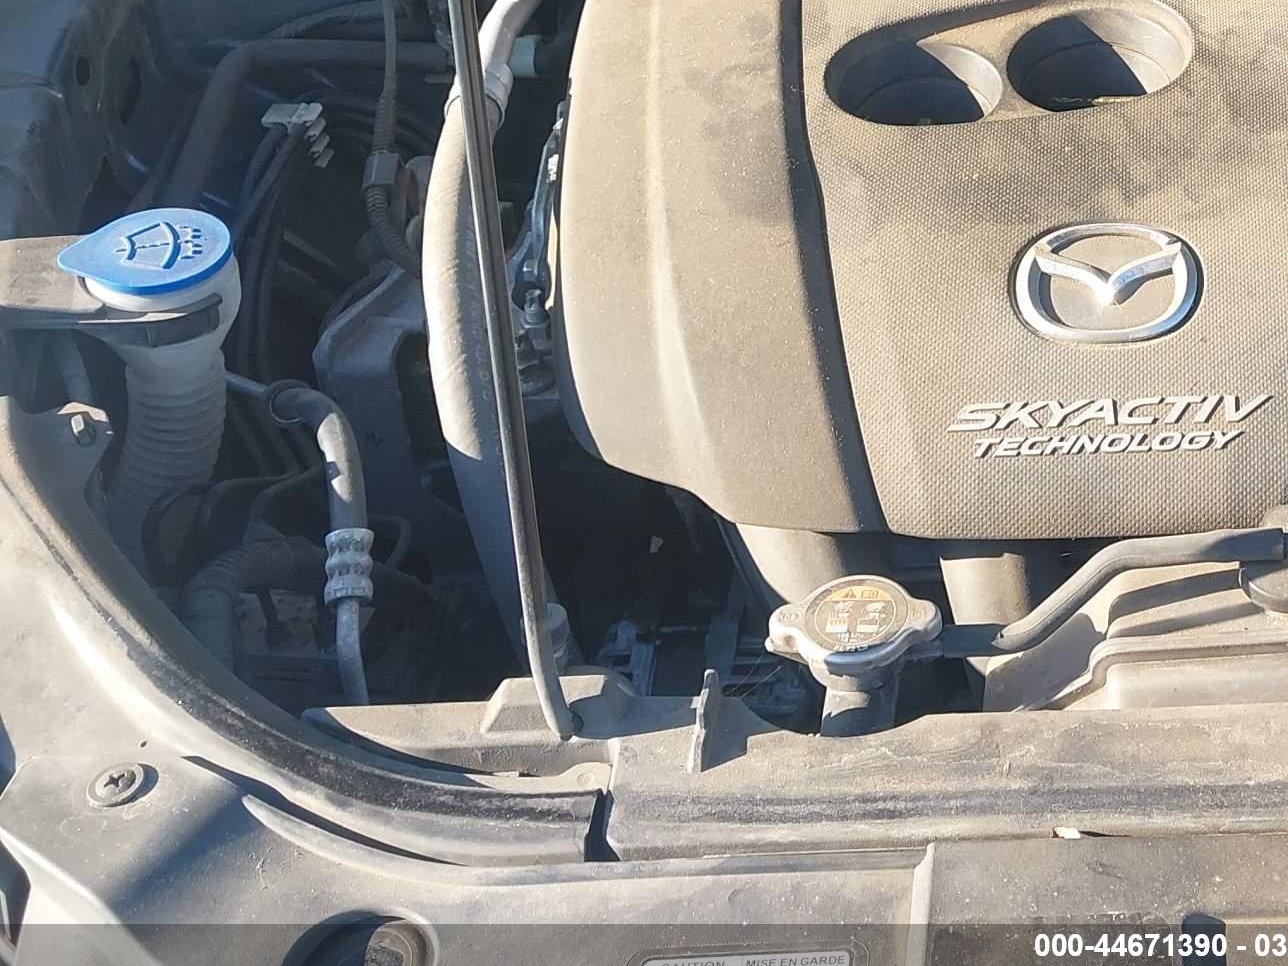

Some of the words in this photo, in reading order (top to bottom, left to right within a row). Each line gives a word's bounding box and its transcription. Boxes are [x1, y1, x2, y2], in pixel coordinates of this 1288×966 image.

[946, 393, 1274, 433] SKYACTIV
[973, 429, 1246, 459] TECHNOLOGY
[780, 957, 798, 966] EN
[800, 955, 846, 965] GARDE
